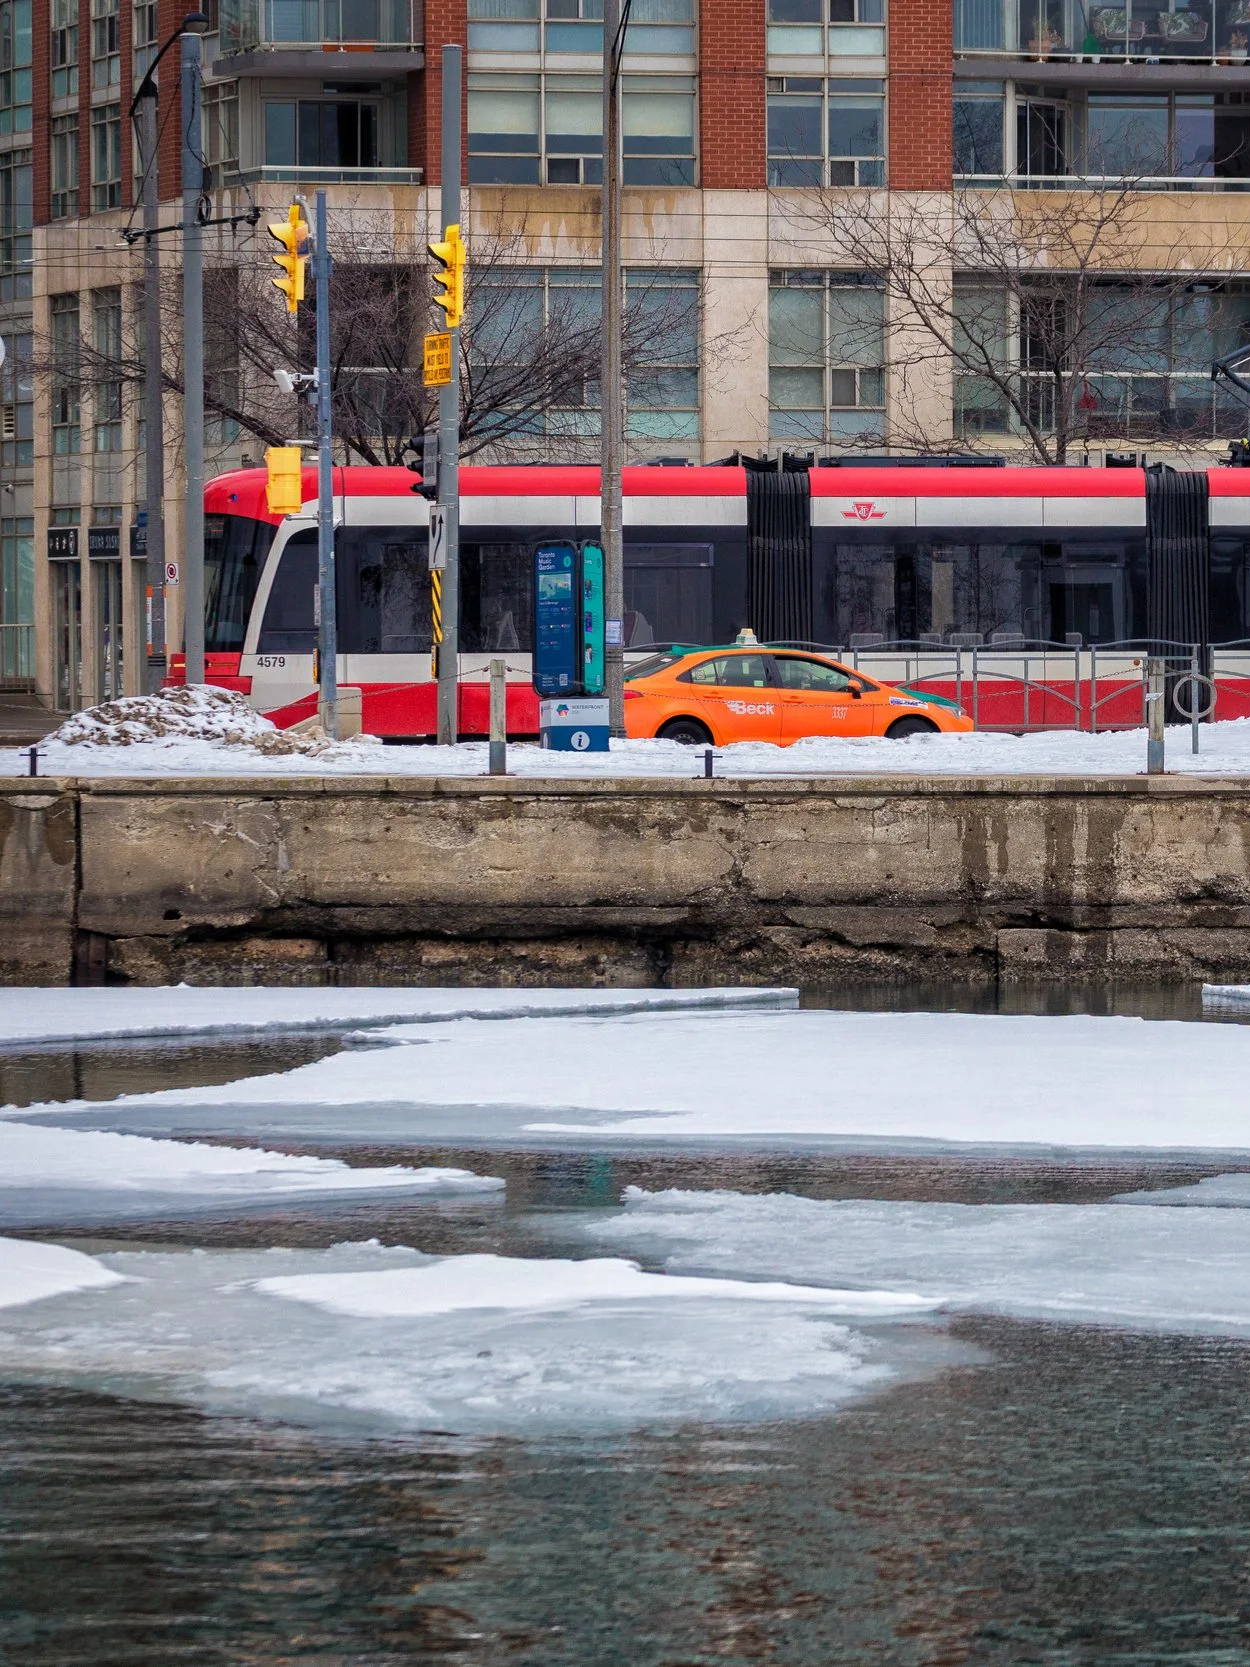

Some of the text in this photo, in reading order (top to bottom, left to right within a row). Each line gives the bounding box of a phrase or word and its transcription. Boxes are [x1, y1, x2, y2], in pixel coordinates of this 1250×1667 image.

[257, 656, 286, 668] 4579
[735, 700, 776, 715] Beck
[832, 706, 848, 720] 3337
